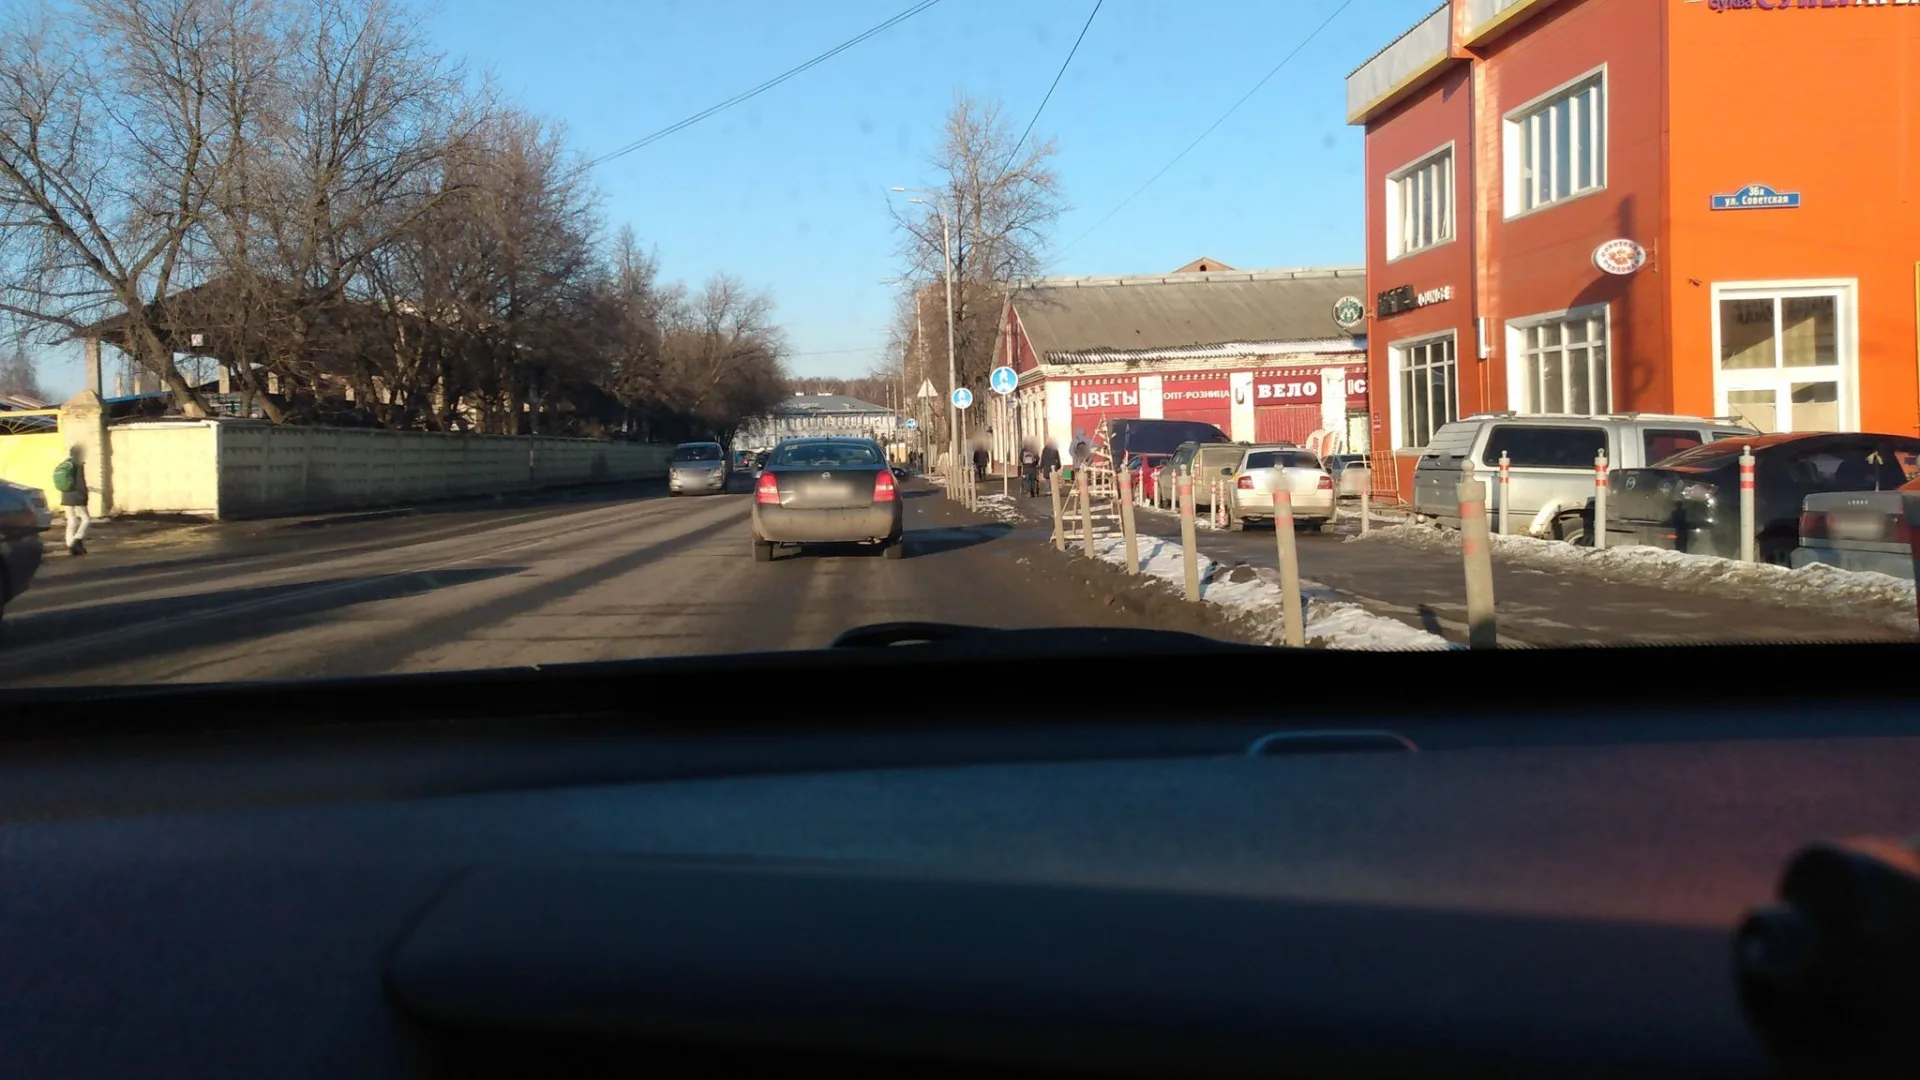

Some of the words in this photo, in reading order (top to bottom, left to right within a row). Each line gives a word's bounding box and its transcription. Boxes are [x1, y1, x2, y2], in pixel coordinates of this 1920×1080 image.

[1724, 197, 1739, 207] ул.
[1742, 195, 1789, 205] Советская
[1163, 389, 1230, 400] ОПТ-РОЗНИЦА
[1257, 381, 1318, 399] ВЕЛО
[1073, 390, 1138, 409] ЦВЕТЫ
